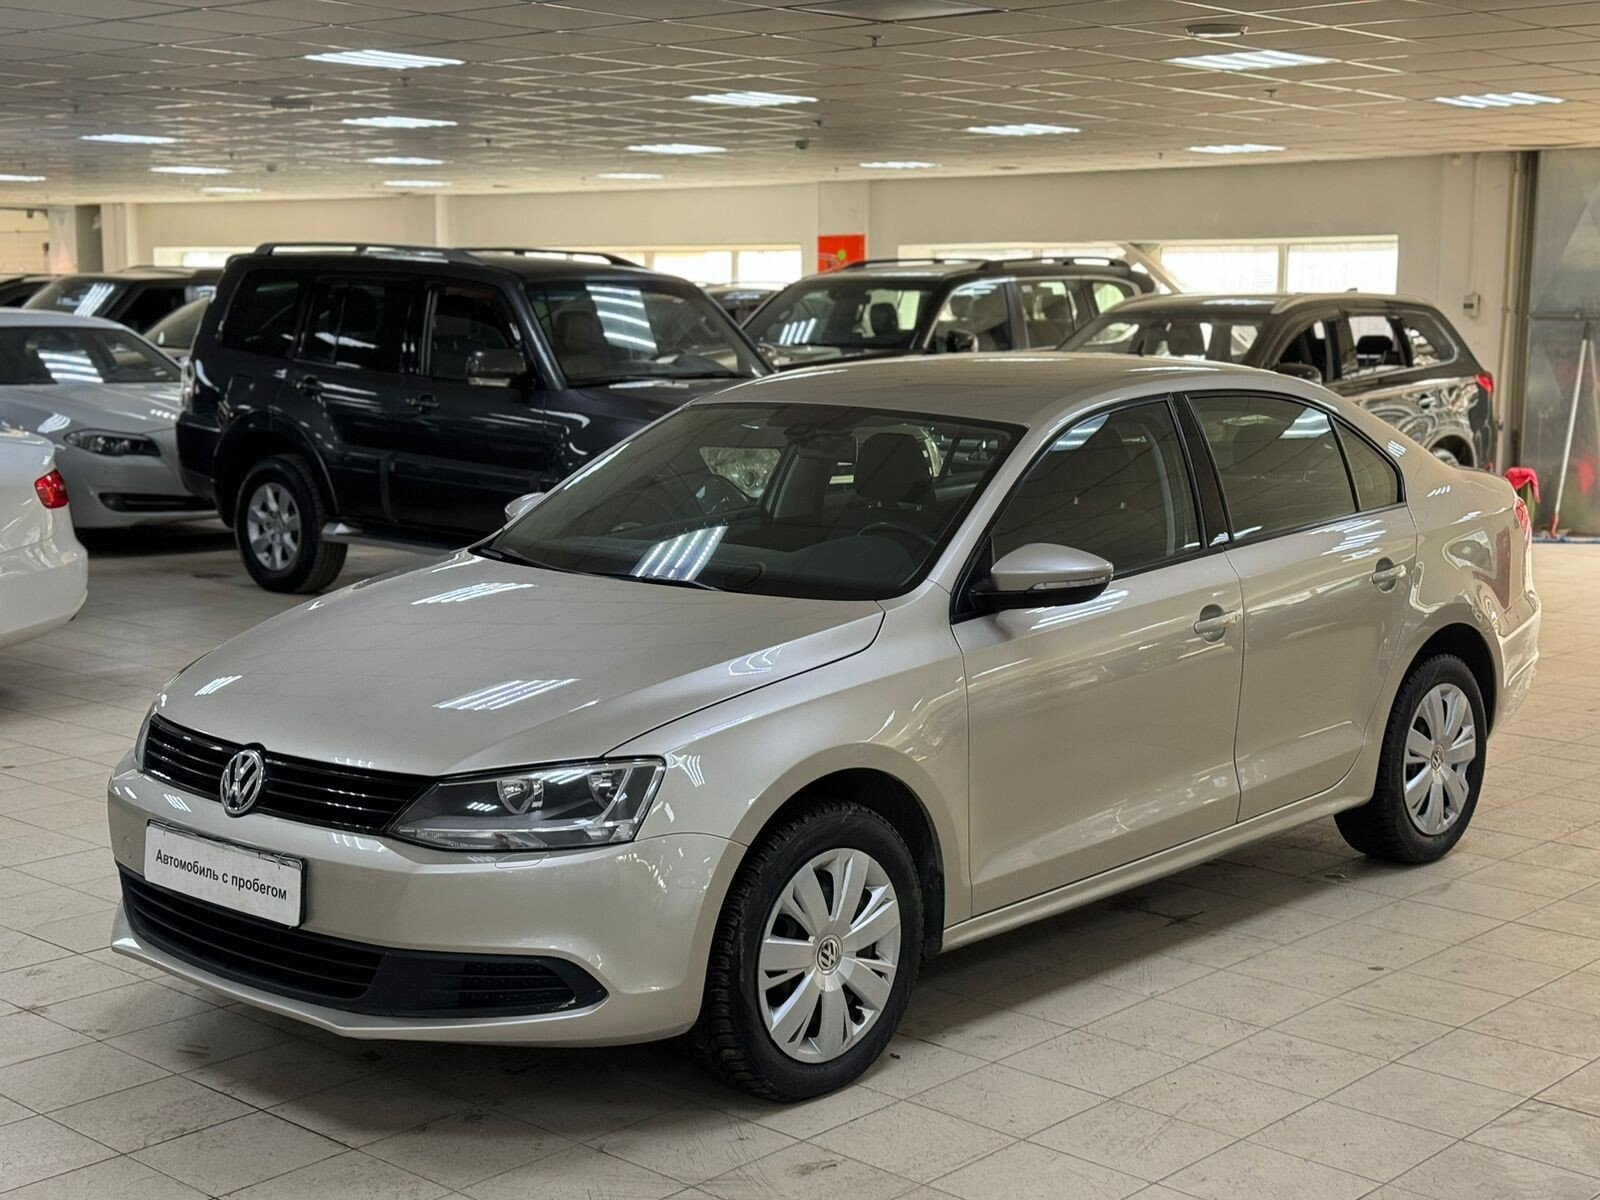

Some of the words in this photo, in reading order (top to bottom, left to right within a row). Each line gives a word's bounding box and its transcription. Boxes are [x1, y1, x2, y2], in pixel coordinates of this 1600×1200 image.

[156, 849, 219, 881] Автомобиль
[221, 872, 229, 884] с
[231, 874, 287, 901] пробегом
